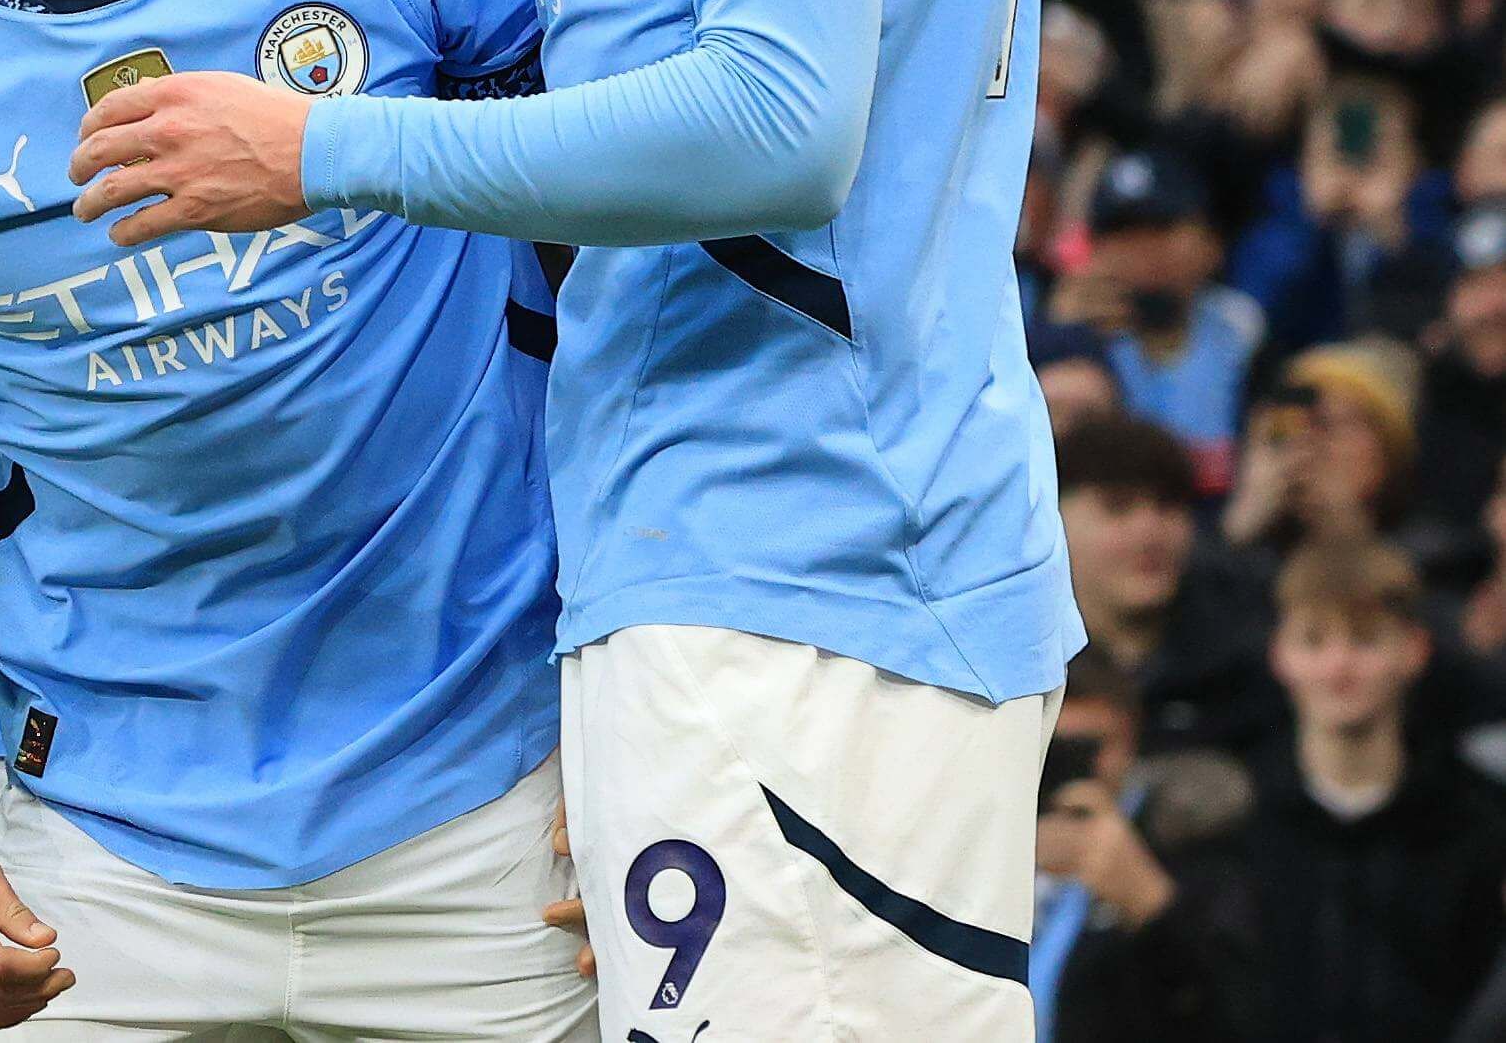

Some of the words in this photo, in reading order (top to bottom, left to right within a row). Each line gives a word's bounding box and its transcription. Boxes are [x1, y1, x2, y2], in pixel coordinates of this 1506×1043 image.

[264, 10, 347, 60] MANCHESTER
[86, 270, 350, 392] AIRWAYS
[624, 839, 727, 1010] 9
